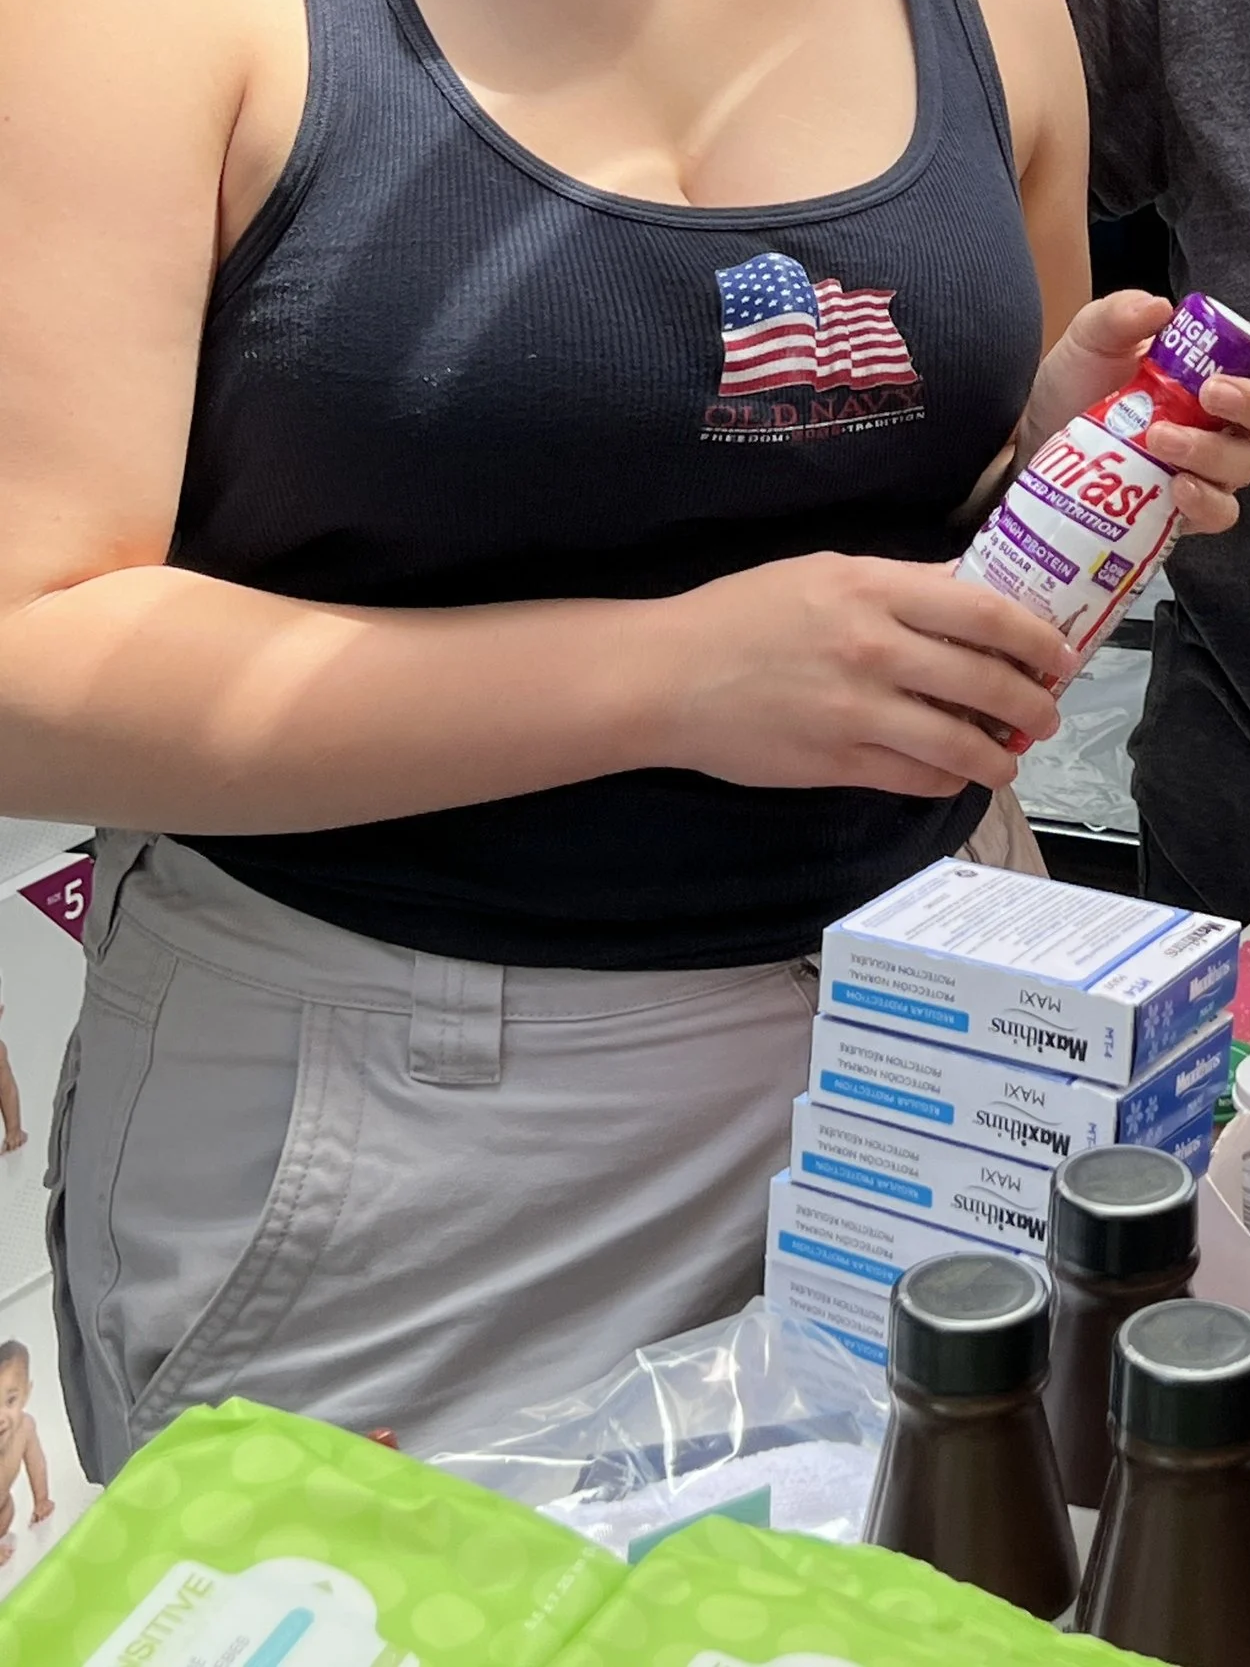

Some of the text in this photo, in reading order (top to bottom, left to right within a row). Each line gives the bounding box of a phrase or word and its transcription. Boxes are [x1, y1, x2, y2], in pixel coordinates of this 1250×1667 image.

[1172, 307, 1219, 353] HIGH
[704, 386, 923, 427] OLD NAVY
[1048, 491, 1123, 540] NUTRITION
[999, 541, 1032, 573] SUGAR
[1002, 514, 1073, 579] HIGH PROTEIN
[64, 878, 84, 920] 5
[849, 969, 890, 987] NORMAL
[898, 965, 955, 987] PROTECTION
[1189, 960, 1231, 1002] Maxithins
[846, 990, 955, 1024] REGULAR PROTECTION
[1019, 989, 1062, 1012] MAXI
[991, 1017, 1114, 1062] Maxithins MT-4
[838, 1058, 877, 1077] NORMAL
[885, 1054, 942, 1078] PROTECTION
[834, 1080, 940, 1116] REGULAR PROTECTION
[1004, 1082, 1046, 1107] MAXI
[976, 1109, 1098, 1157] Maxithins MT-
[818, 1141, 857, 1160] NORMAL
[816, 1161, 874, 1185] PROTECTION
[980, 1167, 1021, 1192] MAXI
[954, 1193, 1048, 1242] Maxithins
